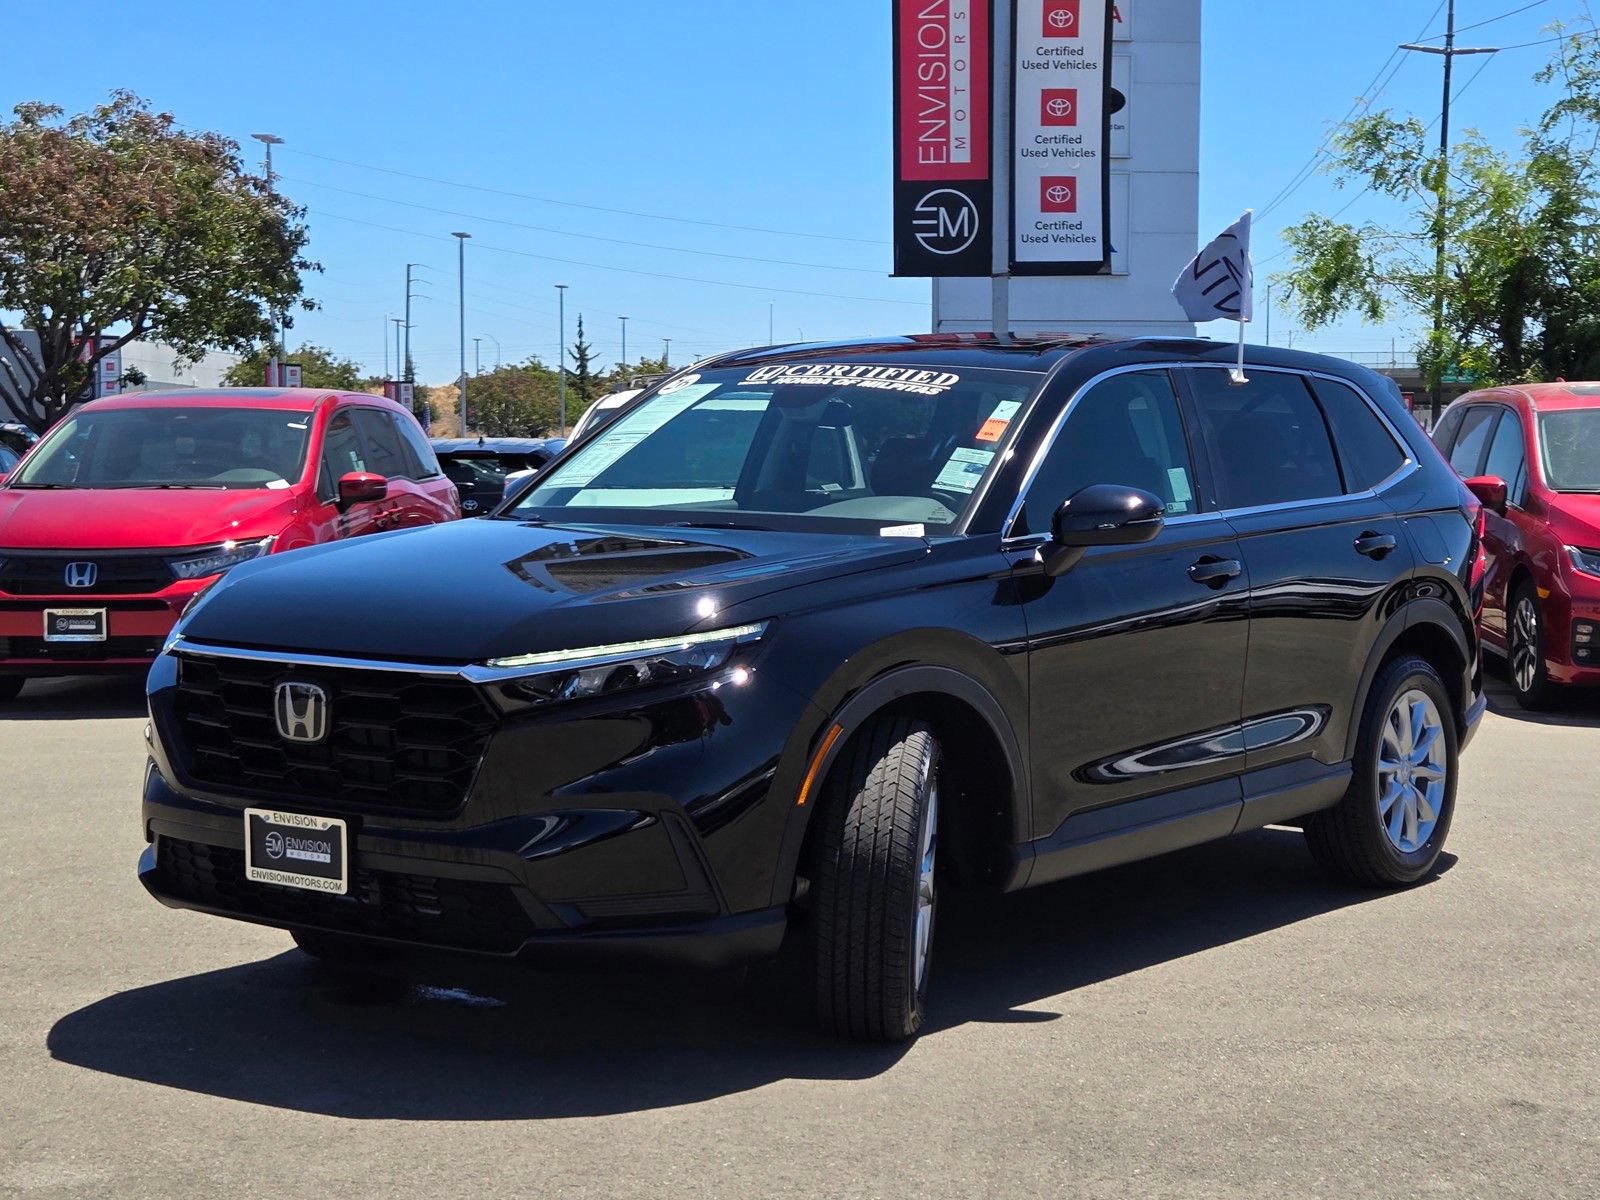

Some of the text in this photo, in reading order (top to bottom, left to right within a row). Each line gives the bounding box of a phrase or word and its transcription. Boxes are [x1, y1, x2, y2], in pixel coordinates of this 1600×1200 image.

[1035, 46, 1084, 57] Certified
[1021, 59, 1098, 70] Used Vehicles
[918, 0, 946, 164] ENVISION
[953, 12, 967, 150] MOTORS
[1034, 134, 1082, 145] Certified
[1020, 148, 1096, 158] Used Vehicles
[1034, 220, 1083, 231] Certified
[1021, 233, 1097, 244] Used Vehicles
[785, 363, 960, 386] CERTIFIED
[771, 376, 943, 395] HONDA OF MILPITAS
[273, 812, 318, 828] ENVISION
[285, 836, 331, 854] ENVISION
[251, 869, 342, 891] ENVISIONMOTORS.COM
